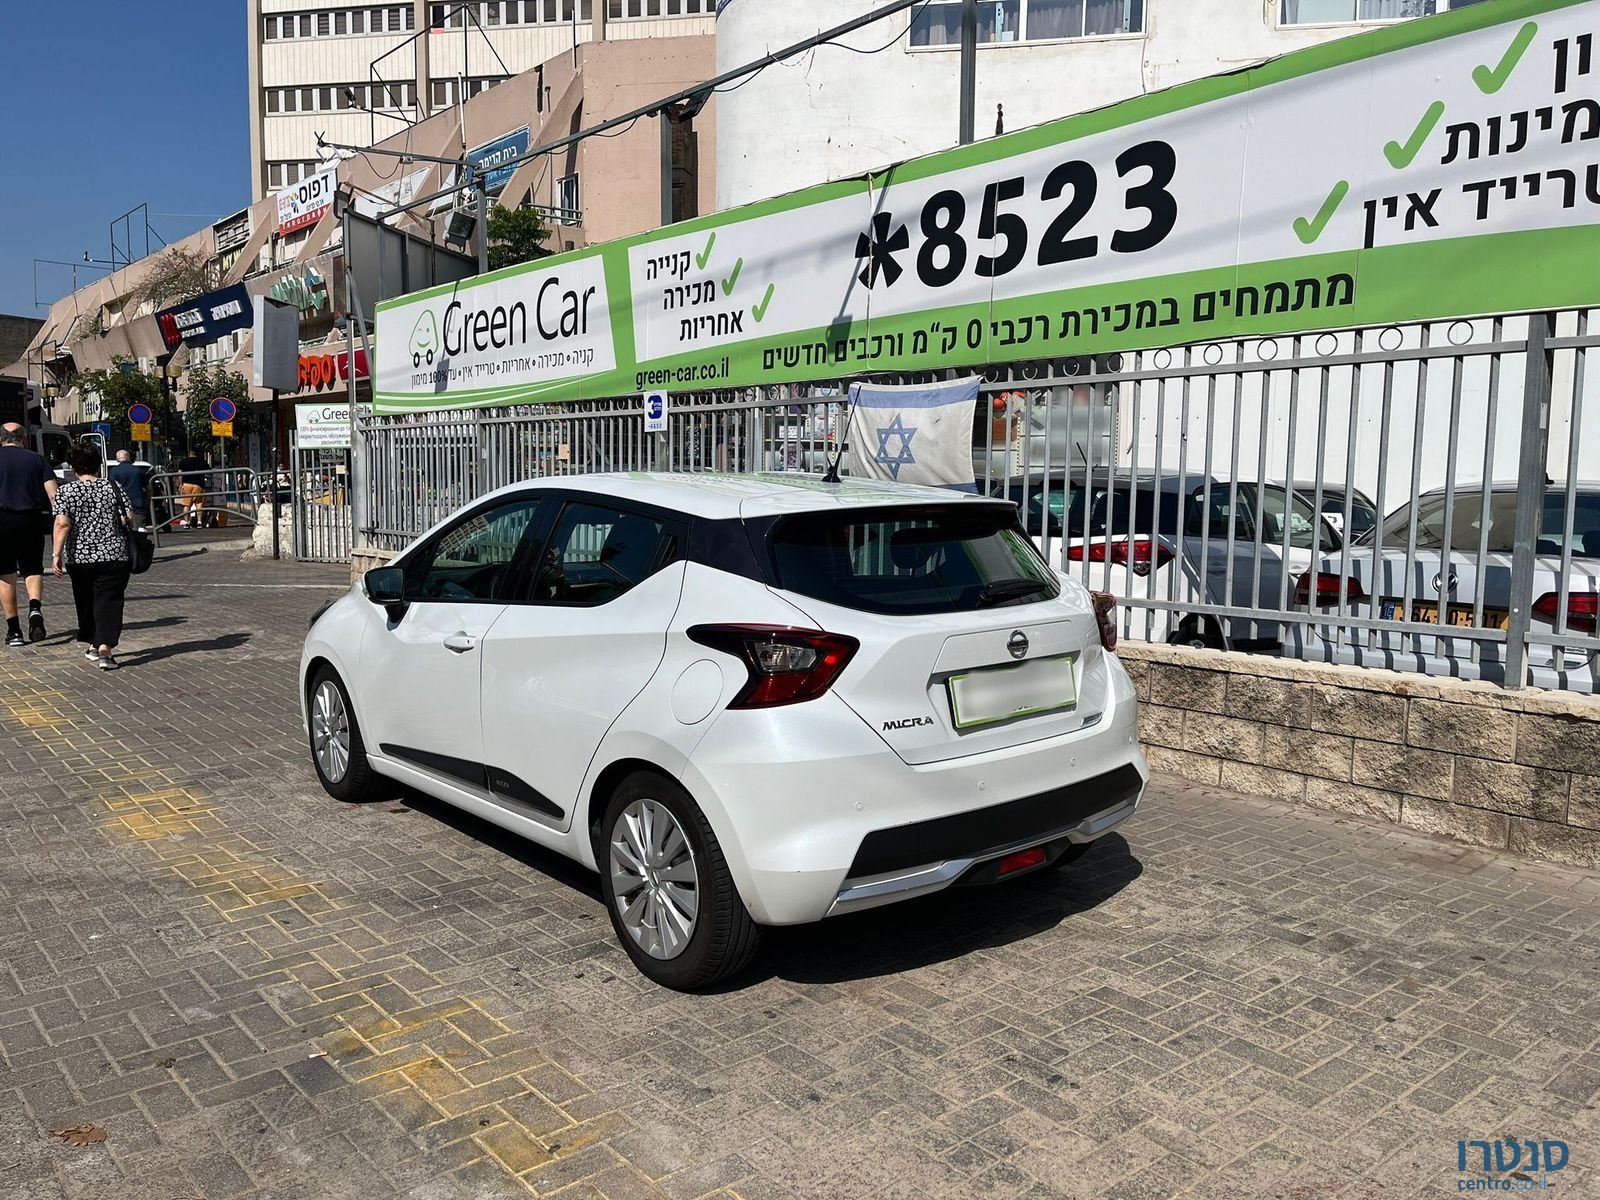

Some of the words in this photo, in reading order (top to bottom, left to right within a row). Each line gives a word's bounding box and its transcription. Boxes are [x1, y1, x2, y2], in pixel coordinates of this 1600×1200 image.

[1553, 33, 1592, 94] ון
[299, 174, 329, 204] דפוס
[282, 206, 328, 230] Типографи
[1363, 188, 1442, 249] אין
[646, 250, 691, 281] קנייה
[663, 280, 716, 310] מכירה
[1192, 272, 1355, 320] מתמחים
[442, 299, 527, 357] Green
[535, 276, 596, 341] Car
[679, 310, 744, 341] אחריות
[1057, 292, 1181, 334] במכירת
[966, 318, 982, 352] 0
[989, 313, 1051, 346] רכבי
[537, 353, 564, 370] מכירה
[572, 348, 594, 367] קניה
[762, 340, 829, 370] חדשים
[834, 331, 905, 364] ורכבים
[411, 372, 428, 389] מימון
[428, 370, 448, 384] 100%
[462, 366, 473, 382] אין
[475, 362, 495, 376] טרייד
[501, 357, 531, 374] אחריות
[635, 357, 730, 390] green-car.co.il
[882, 716, 934, 731] MICRA
